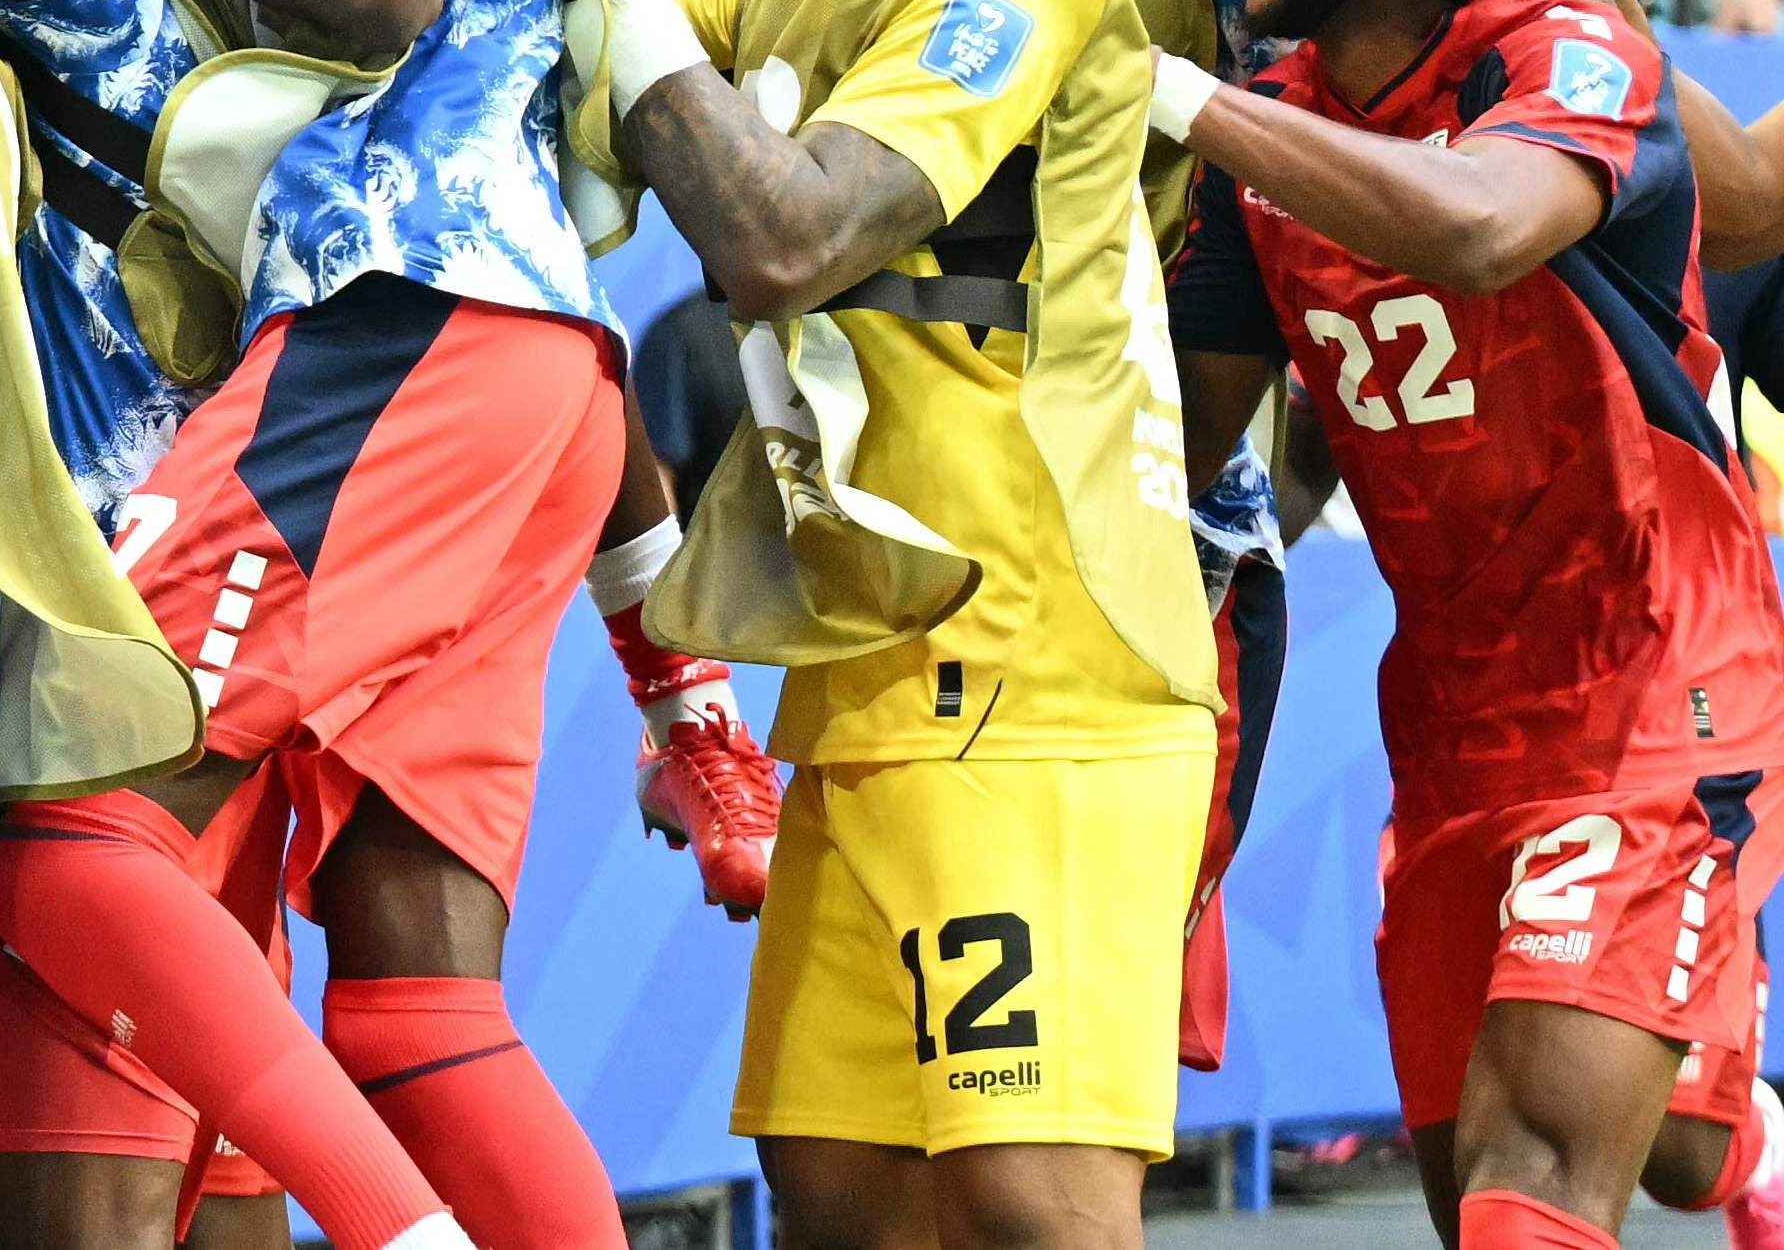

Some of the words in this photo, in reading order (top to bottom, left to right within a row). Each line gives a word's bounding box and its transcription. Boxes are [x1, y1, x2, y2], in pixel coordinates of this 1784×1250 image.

[1304, 293, 1476, 433] 22
[1509, 929, 1593, 958] capelli
[899, 911, 1039, 1067] 12
[948, 1061, 1041, 1095] capelli
[988, 1086, 1042, 1098] SPORT
